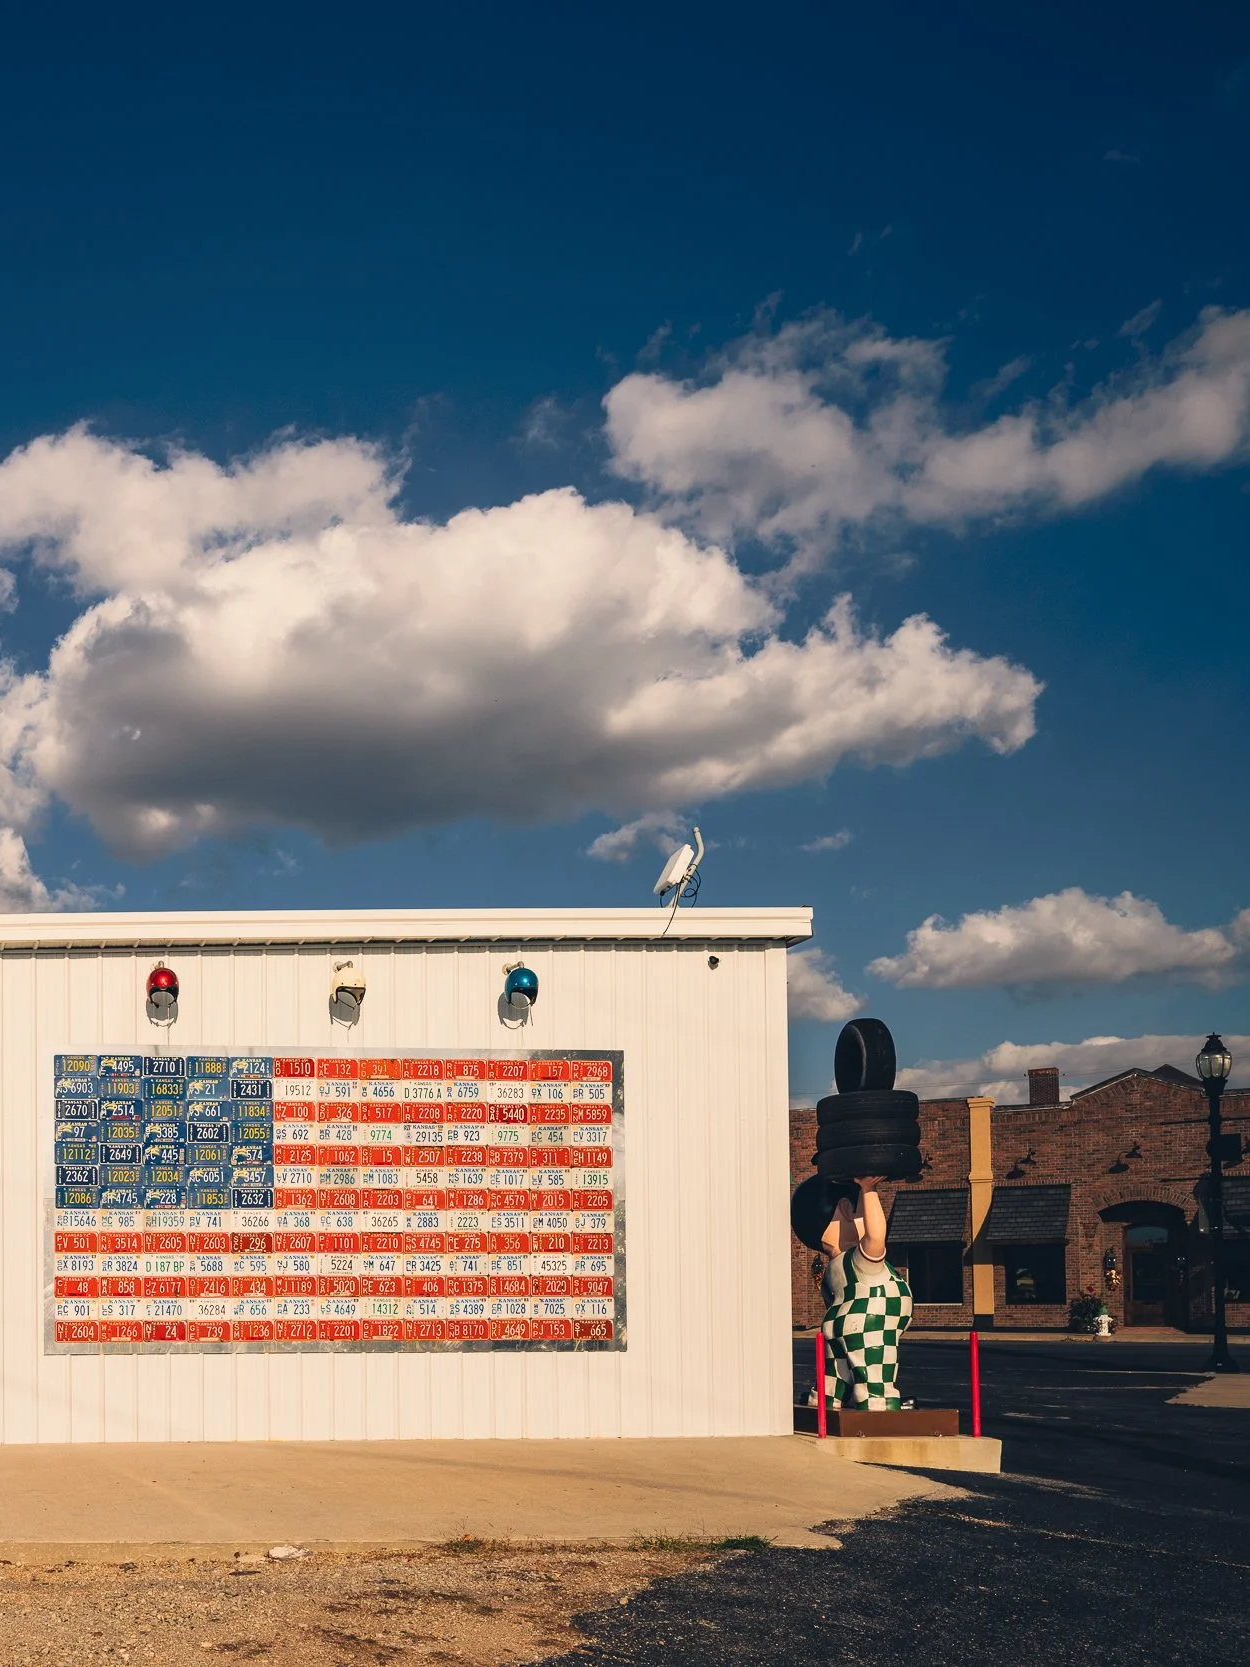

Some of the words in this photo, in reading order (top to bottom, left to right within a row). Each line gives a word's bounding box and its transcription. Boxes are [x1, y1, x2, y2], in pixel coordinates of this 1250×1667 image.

[63, 1060, 90, 1072] 12090
[153, 1061, 175, 1072] 2710
[195, 1062, 222, 1073] 11888
[290, 1063, 311, 1074] 1510
[336, 1064, 351, 1075] 132
[418, 1065, 439, 1076] 2218
[463, 1065, 479, 1076] 875
[503, 1066, 524, 1077] 2207
[548, 1066, 563, 1077] 157
[587, 1066, 608, 1077] 2968
[107, 1083, 134, 1094] 11903
[151, 1083, 178, 1094] 16833
[241, 1084, 261, 1095] 2431
[285, 1085, 311, 1095] 19512
[336, 1086, 351, 1097] 591
[373, 1086, 394, 1097] 4656
[413, 1088, 433, 1098] 3776
[458, 1087, 479, 1098] 6759
[498, 1088, 524, 1099] 36283
[548, 1088, 563, 1099] 106
[589, 1088, 605, 1099] 505
[65, 1105, 88, 1116] 2670
[151, 1106, 177, 1116] 12051
[239, 1106, 265, 1117] 11834
[293, 1107, 308, 1117] 100
[376, 1108, 392, 1118] 517
[419, 1108, 440, 1119] 2208
[461, 1108, 482, 1119] 2220
[503, 1109, 524, 1120] 5440
[545, 1109, 566, 1120] 2235
[107, 1127, 134, 1138] 12035
[197, 1128, 219, 1139] 2602
[239, 1128, 265, 1139] 12055
[293, 1129, 308, 1140] 692
[336, 1130, 352, 1140] 428
[370, 1130, 392, 1140] 9774
[416, 1131, 443, 1142] 29135
[464, 1131, 480, 1141] 923
[498, 1131, 518, 1141] 9775
[548, 1132, 563, 1142] 454
[63, 1149, 90, 1160] 12112
[109, 1149, 132, 1160] 2649
[195, 1149, 220, 1160] 12061
[290, 1150, 311, 1161] 2125
[334, 1151, 355, 1161] 1062
[382, 1151, 392, 1162] 15
[419, 1151, 440, 1162] 2507
[462, 1152, 482, 1162] 2238
[543, 1153, 557, 1163] 311
[66, 1171, 88, 1182] 2362
[108, 1171, 135, 1182] 12023
[152, 1171, 178, 1182] 12034
[416, 1173, 438, 1183] 5458
[548, 1175, 564, 1185] 585
[583, 1175, 608, 1185] 13915
[65, 1193, 91, 1204] 12086
[197, 1194, 223, 1204] 11853
[242, 1194, 263, 1205] 2632
[291, 1194, 312, 1205] 1362
[334, 1194, 355, 1205] 2608
[377, 1195, 398, 1205] 2203
[422, 1195, 438, 1205] 641
[463, 1195, 484, 1206] 1286
[543, 1195, 564, 1206] 2015
[587, 1196, 608, 1206] 2205
[119, 1216, 134, 1227] 985
[207, 1217, 221, 1227] 741
[242, 1217, 269, 1227] 36266
[294, 1217, 310, 1227] 368
[337, 1217, 353, 1227] 638
[372, 1217, 398, 1227] 36265
[417, 1217, 439, 1228] 2883
[458, 1217, 478, 1227] 2223
[591, 1218, 606, 1229] 379
[74, 1238, 89, 1248] 501
[115, 1238, 137, 1248] 3514
[160, 1237, 182, 1249] 2605
[204, 1238, 226, 1249] 2603
[249, 1238, 266, 1249] 296
[290, 1237, 311, 1248] 2607
[334, 1238, 353, 1248] 1101
[377, 1238, 398, 1248] 2210
[465, 1238, 480, 1249] 275
[504, 1238, 520, 1249] 356
[549, 1238, 564, 1249] 210
[588, 1239, 608, 1249] 2213
[156, 1262, 171, 1272] 187
[174, 1261, 184, 1272] BP
[200, 1261, 223, 1271] 5688
[250, 1261, 266, 1271] 595
[294, 1260, 309, 1271] 580
[331, 1260, 353, 1270] 5224
[379, 1261, 395, 1271] 647
[463, 1261, 477, 1271] 741
[507, 1260, 522, 1271] 851
[541, 1261, 567, 1271] 45325
[591, 1261, 606, 1271] 695
[77, 1282, 88, 1293] 48
[118, 1282, 134, 1293] 858
[204, 1282, 226, 1293] 2416
[250, 1282, 266, 1293] 434
[379, 1281, 395, 1292] 623
[422, 1282, 438, 1292] 406
[588, 1282, 608, 1292] 9047
[75, 1305, 90, 1316] 901
[119, 1305, 135, 1316] 317
[155, 1305, 182, 1315] 21470
[198, 1305, 226, 1315] 36284
[250, 1305, 266, 1315] 656
[294, 1304, 310, 1315] 233
[372, 1304, 398, 1314] 14312
[419, 1304, 435, 1314] 514
[544, 1304, 565, 1314] 7025
[592, 1304, 606, 1314] 116
[72, 1326, 94, 1338] 2604
[116, 1326, 137, 1337] 1266
[165, 1326, 177, 1338] 24
[207, 1327, 223, 1337] 739
[249, 1325, 270, 1337] 1236
[291, 1325, 312, 1337] 2712
[334, 1325, 354, 1336] 2201
[378, 1325, 398, 1336] 1822
[420, 1324, 442, 1336] 2713
[505, 1324, 526, 1336] 4649
[550, 1324, 565, 1335] 153
[591, 1324, 606, 1336] 665
